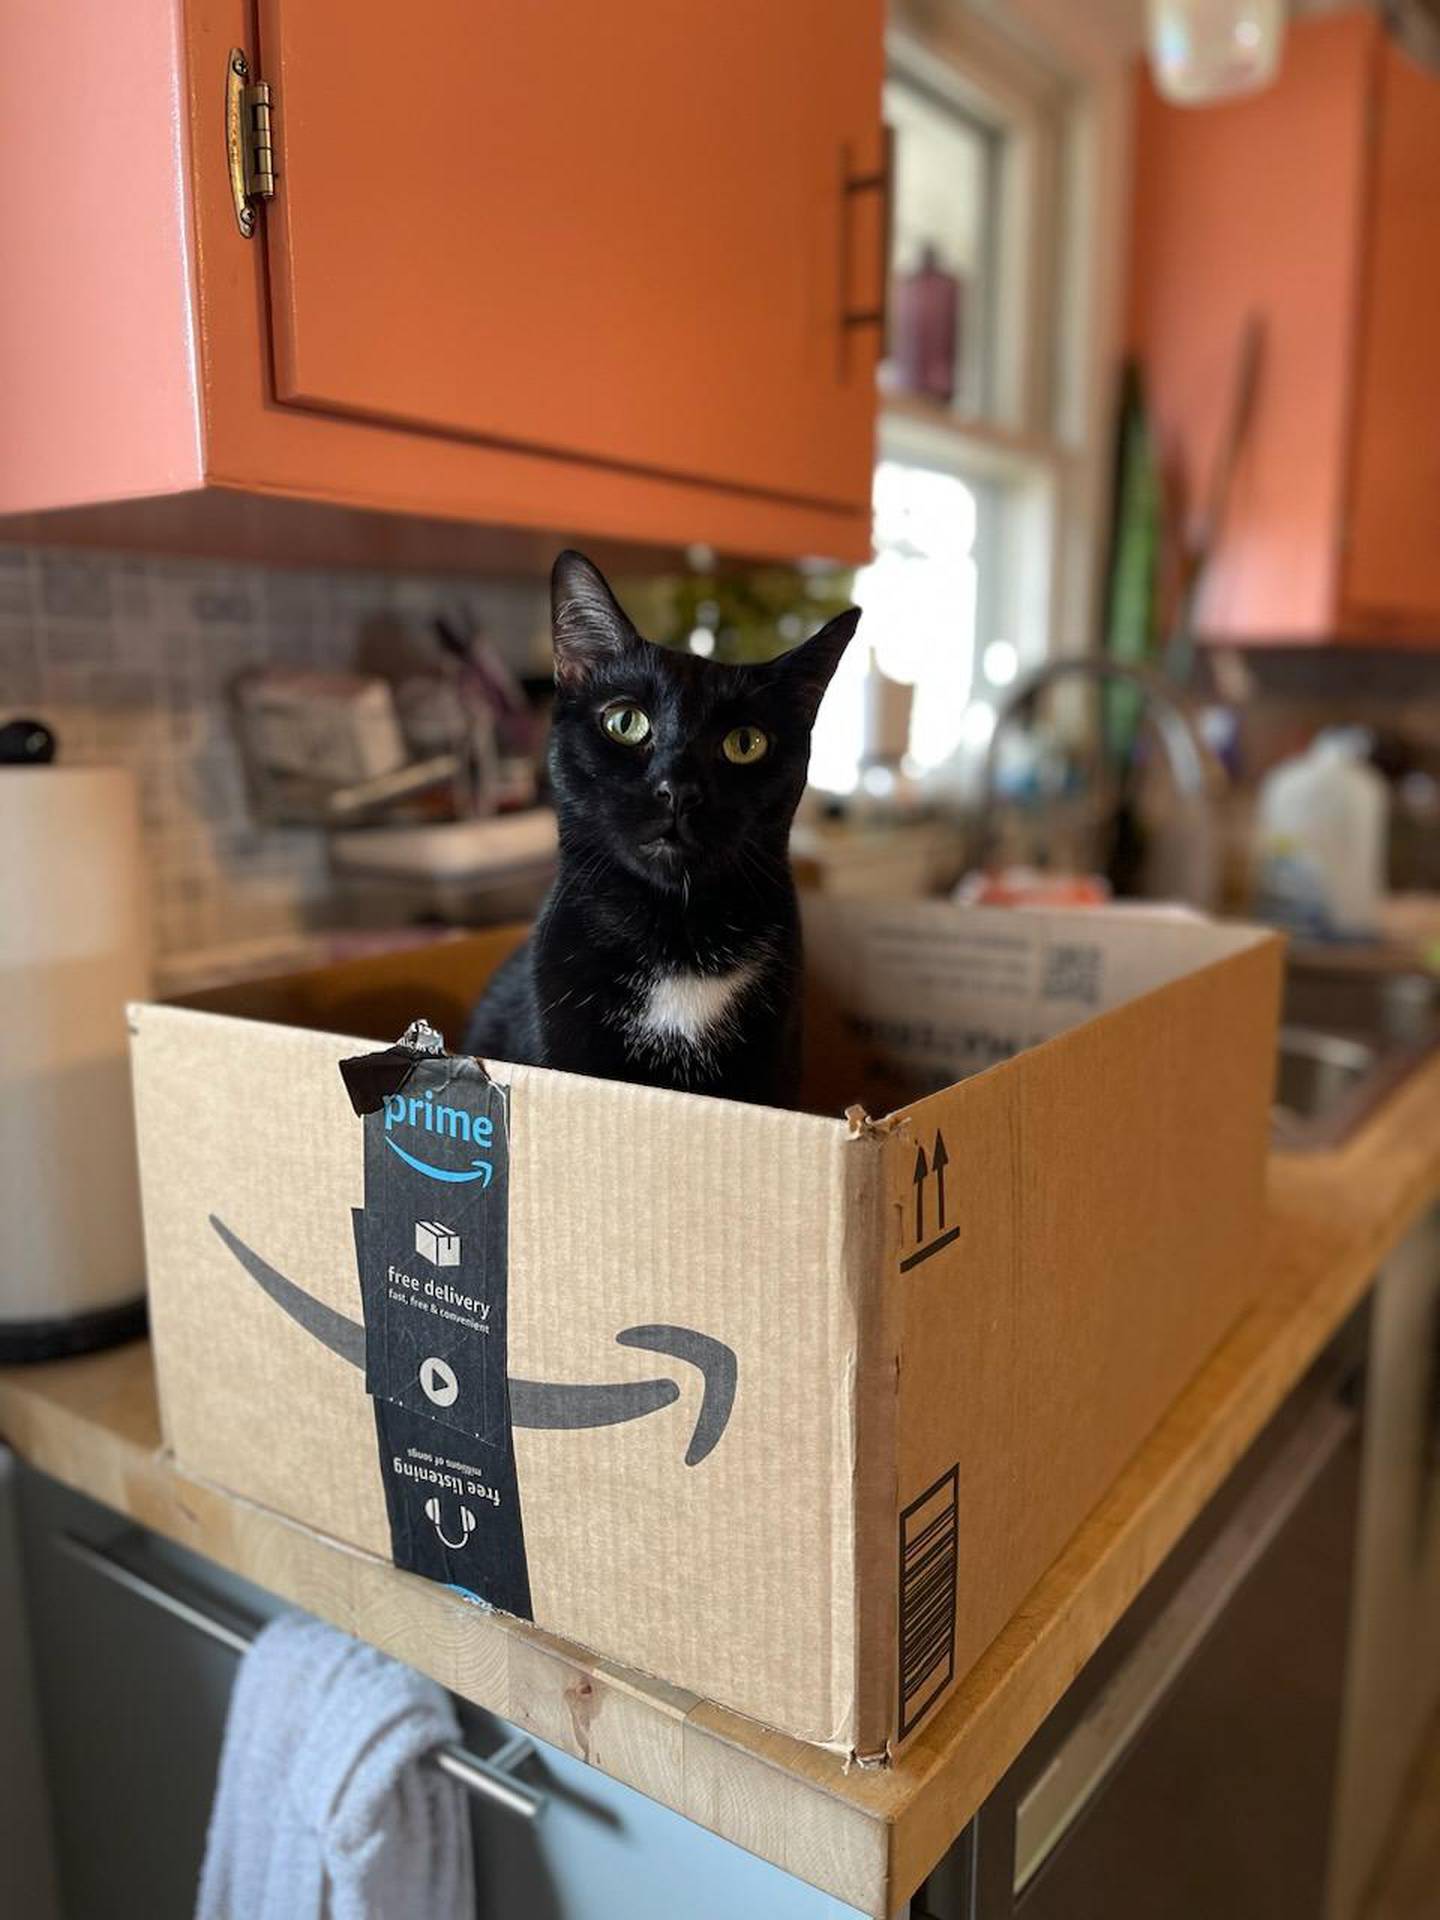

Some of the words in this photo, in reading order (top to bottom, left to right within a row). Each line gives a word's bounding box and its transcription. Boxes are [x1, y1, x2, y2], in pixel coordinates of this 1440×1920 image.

[384, 1090, 493, 1147] prime
[388, 1265, 420, 1291] free
[424, 1279, 490, 1320] delivery
[388, 1288, 409, 1305] fast,
[410, 1295, 429, 1312] free
[430, 1303, 438, 1315] &
[440, 1309, 490, 1334] convenient
[407, 1448, 433, 1462] songs
[435, 1457, 444, 1466] of
[446, 1460, 481, 1476] millions
[394, 1457, 463, 1495] listening
[467, 1481, 501, 1506] free
